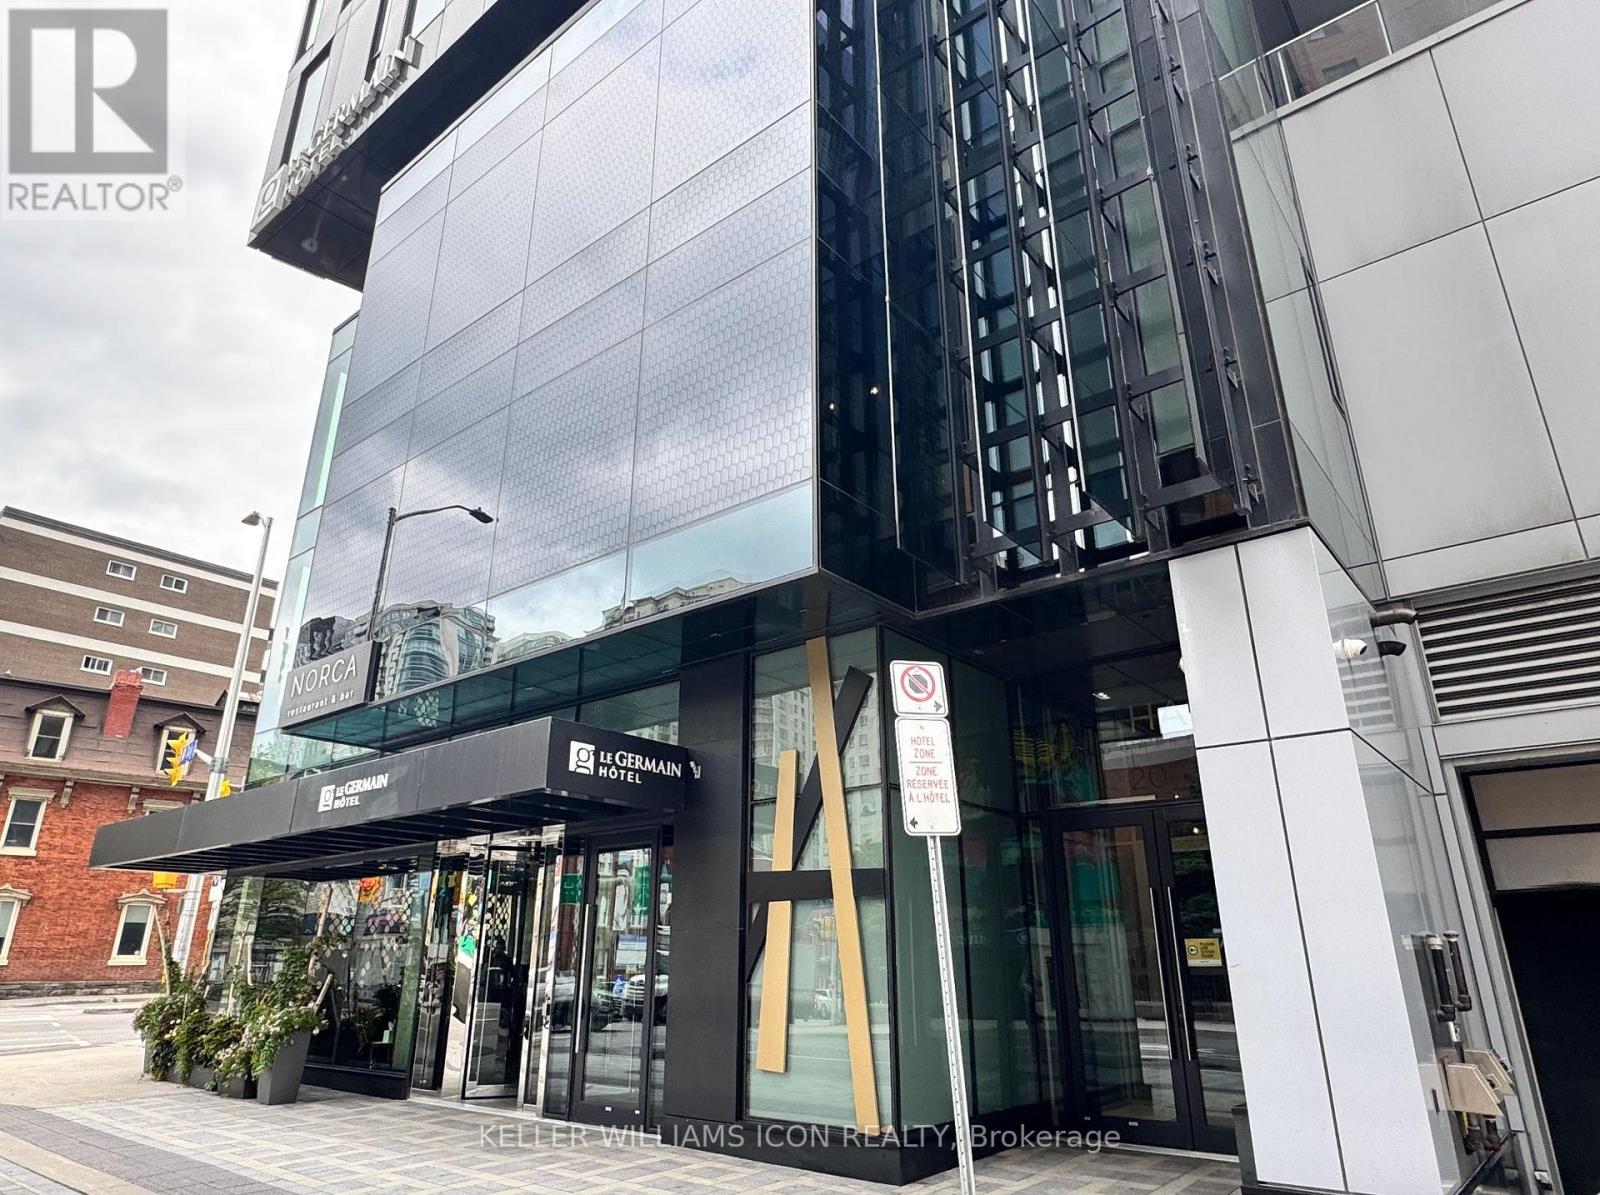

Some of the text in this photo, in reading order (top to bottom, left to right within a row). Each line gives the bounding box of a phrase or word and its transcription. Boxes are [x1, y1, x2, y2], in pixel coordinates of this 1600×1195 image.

[290, 653, 357, 698] NORCA
[287, 698, 328, 718] restaurant
[340, 690, 354, 701] bar
[911, 736, 936, 746] HOTEL
[914, 748, 935, 759] ZONE
[600, 751, 682, 778] LE GERMAIN
[916, 766, 938, 776] ZONE
[599, 765, 642, 784] HÔTEL
[335, 773, 390, 797] LE GERMAIN
[333, 796, 360, 809] HÔTEL
